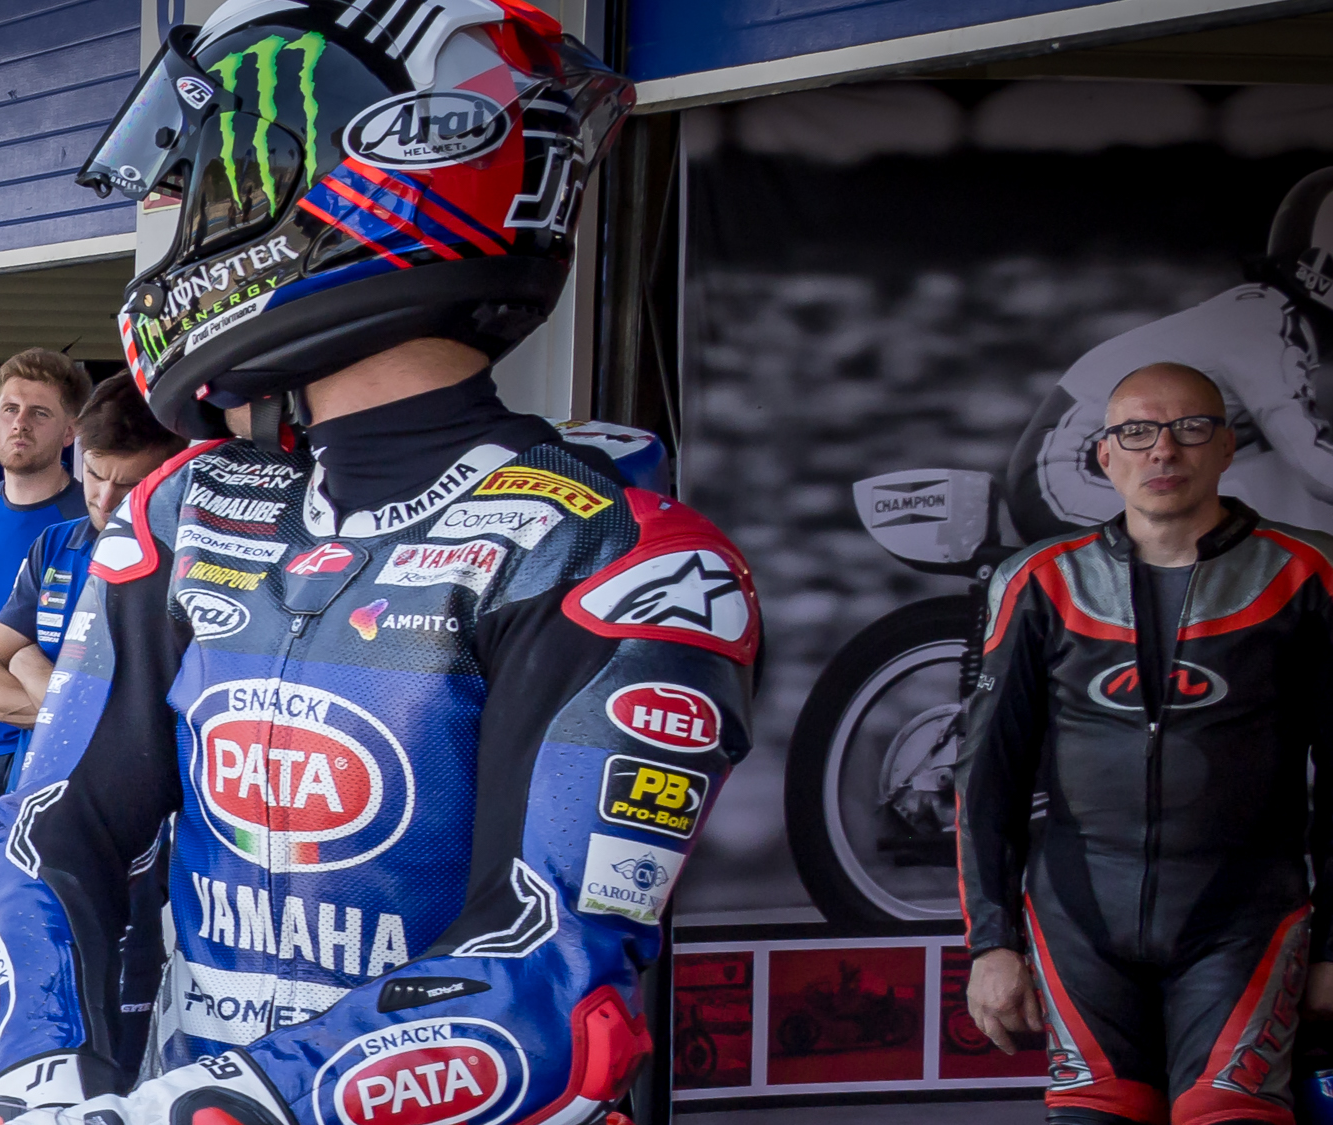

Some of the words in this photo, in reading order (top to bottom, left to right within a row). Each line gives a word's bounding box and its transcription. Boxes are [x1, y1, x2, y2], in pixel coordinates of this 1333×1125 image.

[360, 101, 487, 154] Arai
[1295, 264, 1330, 293] agv
[183, 275, 280, 331] ENERGY
[196, 454, 304, 480] SEMAKIN
[185, 483, 286, 524] YAMALUBE
[372, 462, 479, 531] YAMAHA
[483, 471, 604, 513] PIRELLI
[874, 492, 947, 514] CHAMPION
[444, 509, 537, 530] Corpay
[181, 529, 274, 557] PROMETEON
[419, 543, 498, 573] YAMAHA
[383, 614, 461, 633] AMPITO
[232, 687, 322, 725] SNACK
[631, 704, 711, 744] HEL
[212, 737, 343, 813] PATA
[629, 766, 691, 809] PB
[611, 801, 691, 831] Pro-Bolt
[191, 871, 410, 978] YAMAHA
[363, 1025, 453, 1057] SNACK
[357, 1056, 483, 1120] PATA
